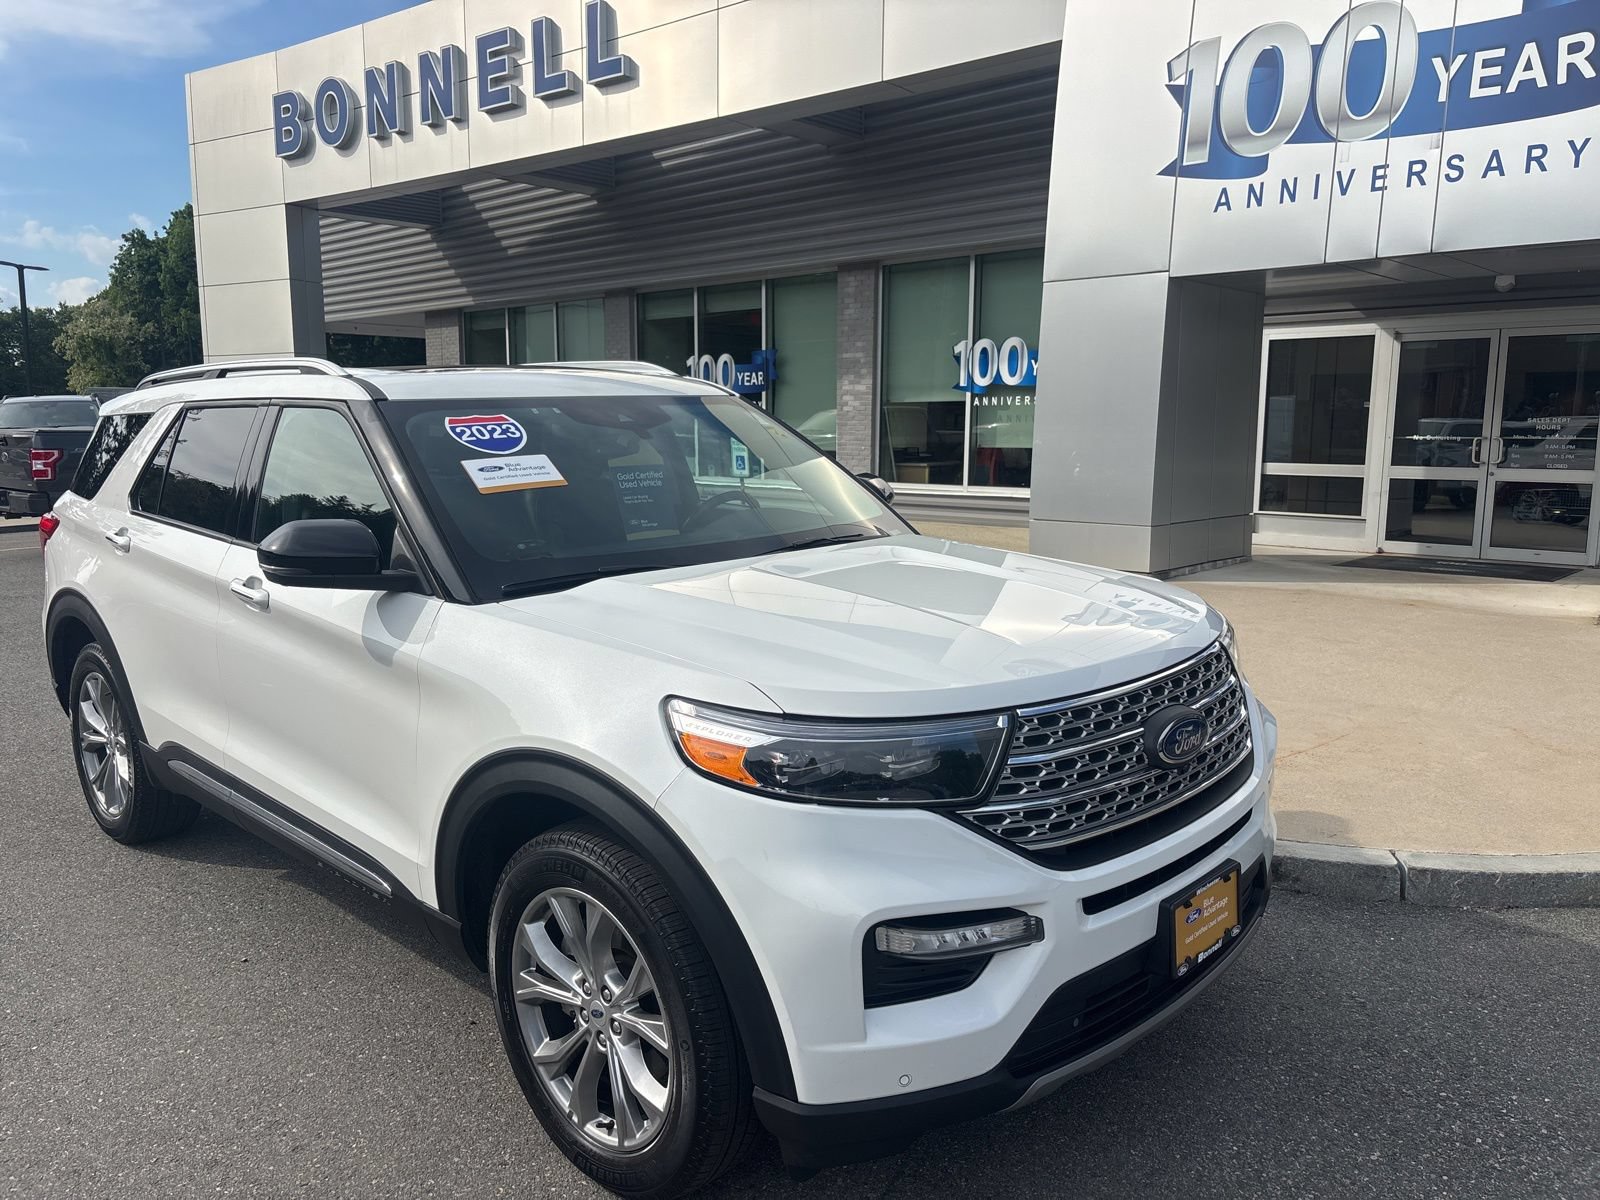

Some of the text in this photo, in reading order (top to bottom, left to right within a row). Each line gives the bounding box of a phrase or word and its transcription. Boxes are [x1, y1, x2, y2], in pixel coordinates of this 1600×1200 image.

[272, 0, 634, 160] BONNELL
[1167, 0, 1597, 166] 100 YEAR
[1213, 137, 1592, 214] ANNIVERSARY
[686, 353, 765, 390] 100 YEAR
[953, 336, 1028, 387] 100
[455, 424, 521, 441] 2023
[616, 471, 664, 481] Gold Certified
[618, 479, 663, 489] Used Vehicle
[685, 722, 753, 743] EXPLORER
[1175, 724, 1203, 755] Ford
[1203, 896, 1215, 908] Blue
[1203, 897, 1229, 919] Advantage
[1197, 938, 1223, 964] Bonnell
